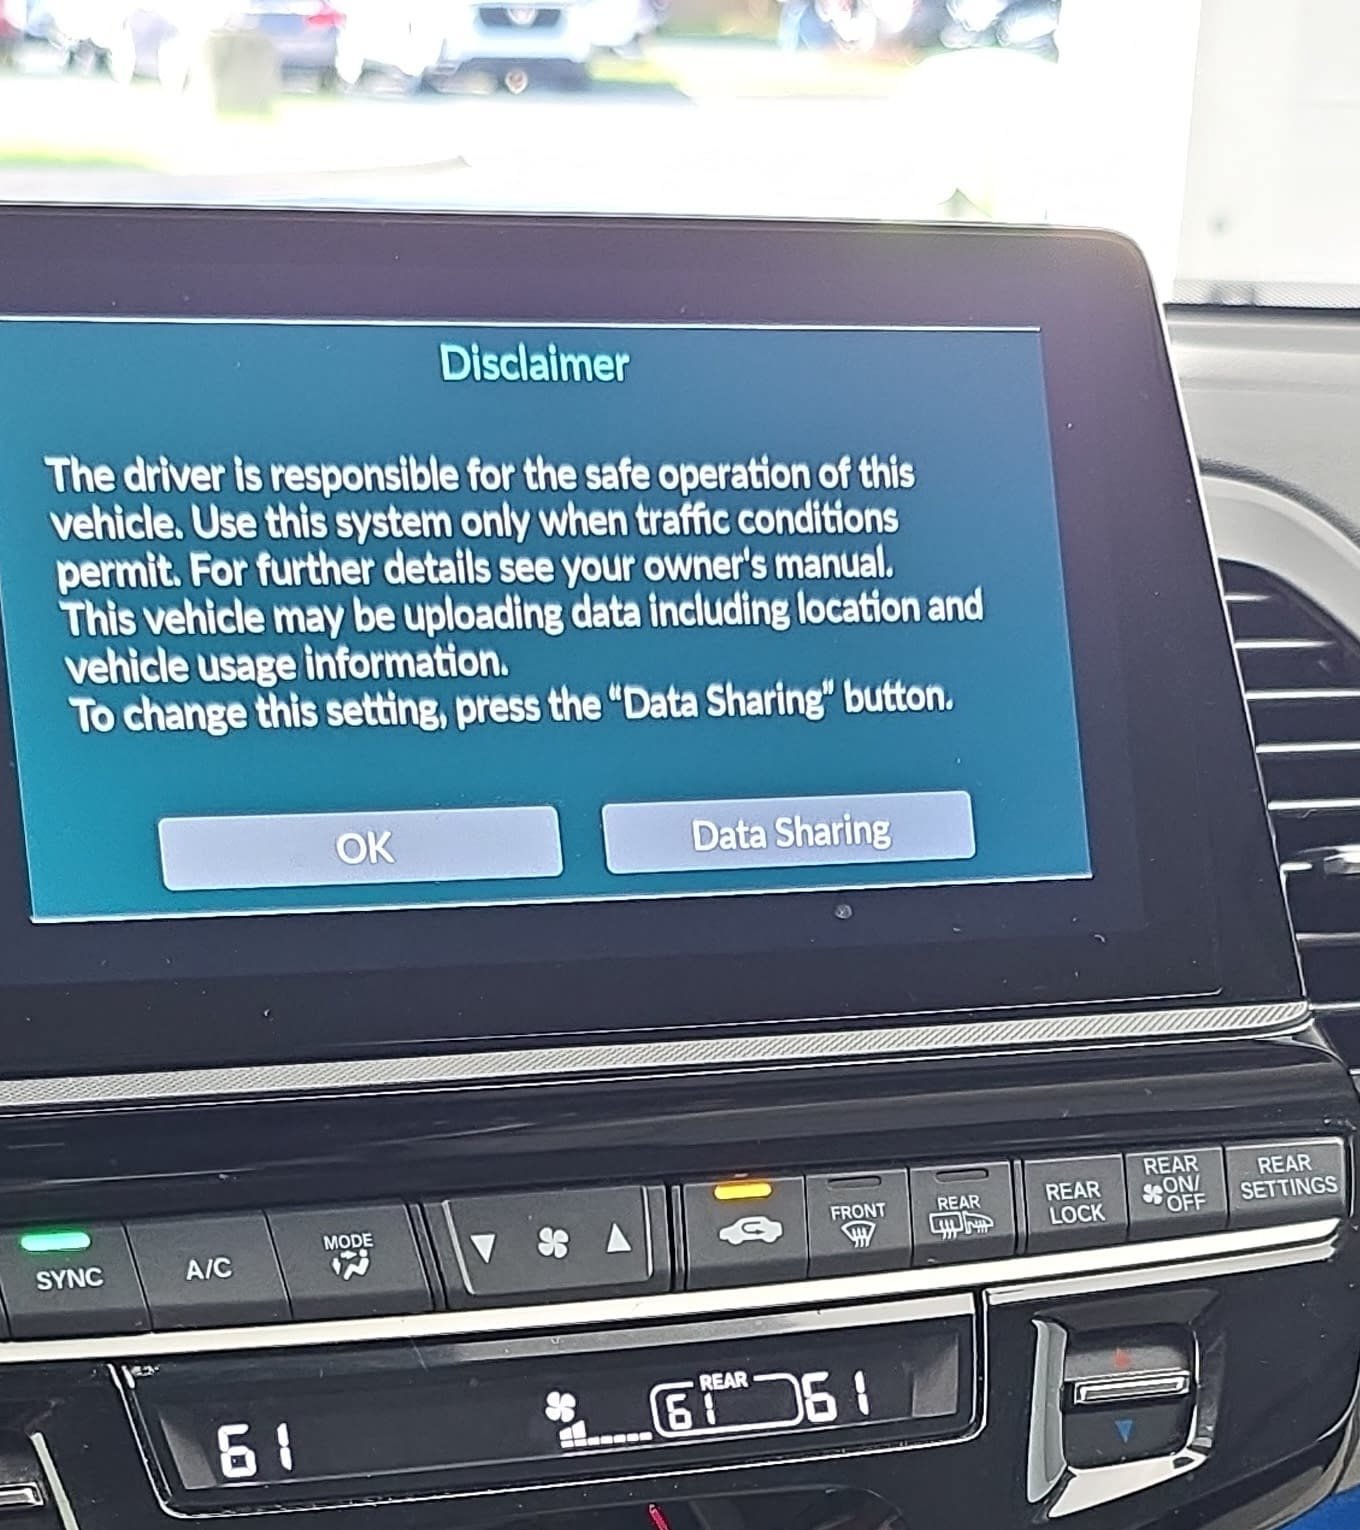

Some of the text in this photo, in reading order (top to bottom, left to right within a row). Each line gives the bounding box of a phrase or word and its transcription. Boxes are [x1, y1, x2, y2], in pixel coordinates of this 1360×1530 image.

[440, 342, 631, 383] Disclaimer
[45, 455, 915, 499] The driver is responsible for the safe operation of this
[50, 500, 899, 545] vehicle. Use this system only when traffic conditions
[57, 546, 894, 595] permit. For further details see your owner's manual.
[60, 588, 983, 639] This vehicle may be uploading data including location and
[65, 643, 509, 690] vehicle usage information.
[71, 696, 115, 733] To
[123, 695, 247, 736] change
[255, 694, 319, 729] this
[327, 690, 448, 732] setting,
[456, 695, 541, 731] press
[548, 685, 602, 720] the
[844, 681, 954, 714] button.
[692, 813, 892, 853] Data Sharing
[337, 831, 395, 866] OK
[1143, 1155, 1199, 1176] REAR
[1258, 1154, 1313, 1175] REAR
[1046, 1178, 1100, 1202] REAR
[1163, 1172, 1202, 1195] ON/
[1241, 1172, 1339, 1199] SETTINGS
[831, 1201, 886, 1222] FRONT
[936, 1194, 982, 1213] REAR
[1048, 1201, 1107, 1225] LOCK
[1165, 1190, 1207, 1213] OFF
[323, 1233, 374, 1252] MODE
[37, 1268, 105, 1293] SYNC
[186, 1257, 233, 1282] A/C
[699, 1369, 749, 1391] REAR
[665, 1391, 715, 1432] 61
[800, 1371, 871, 1425] 61
[216, 1422, 294, 1480] 61
